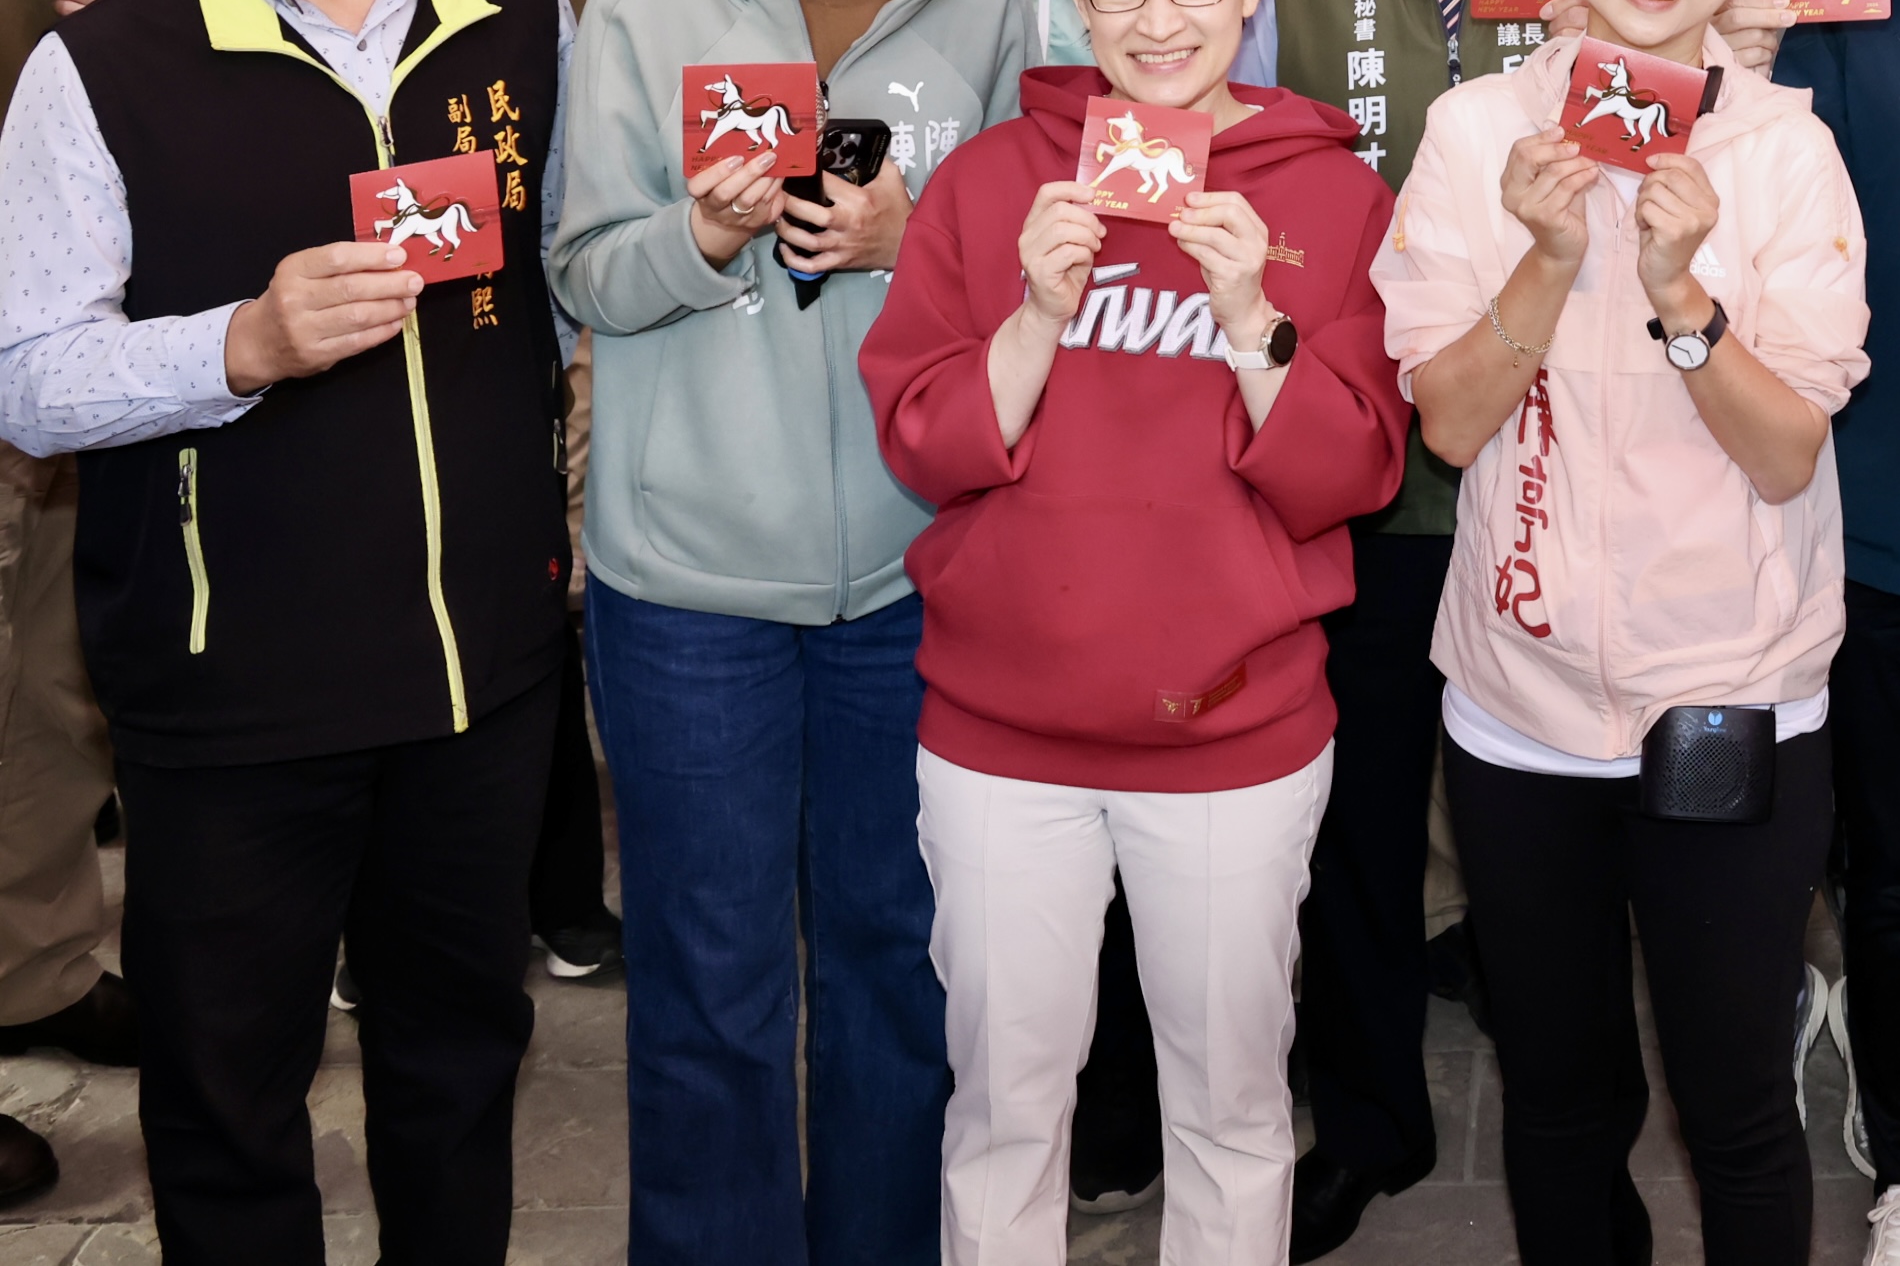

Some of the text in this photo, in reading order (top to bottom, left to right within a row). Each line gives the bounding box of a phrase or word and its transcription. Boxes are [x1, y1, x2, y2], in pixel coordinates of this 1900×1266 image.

[1496, 22, 1545, 46] 議長
[486, 79, 528, 213] 民政局
